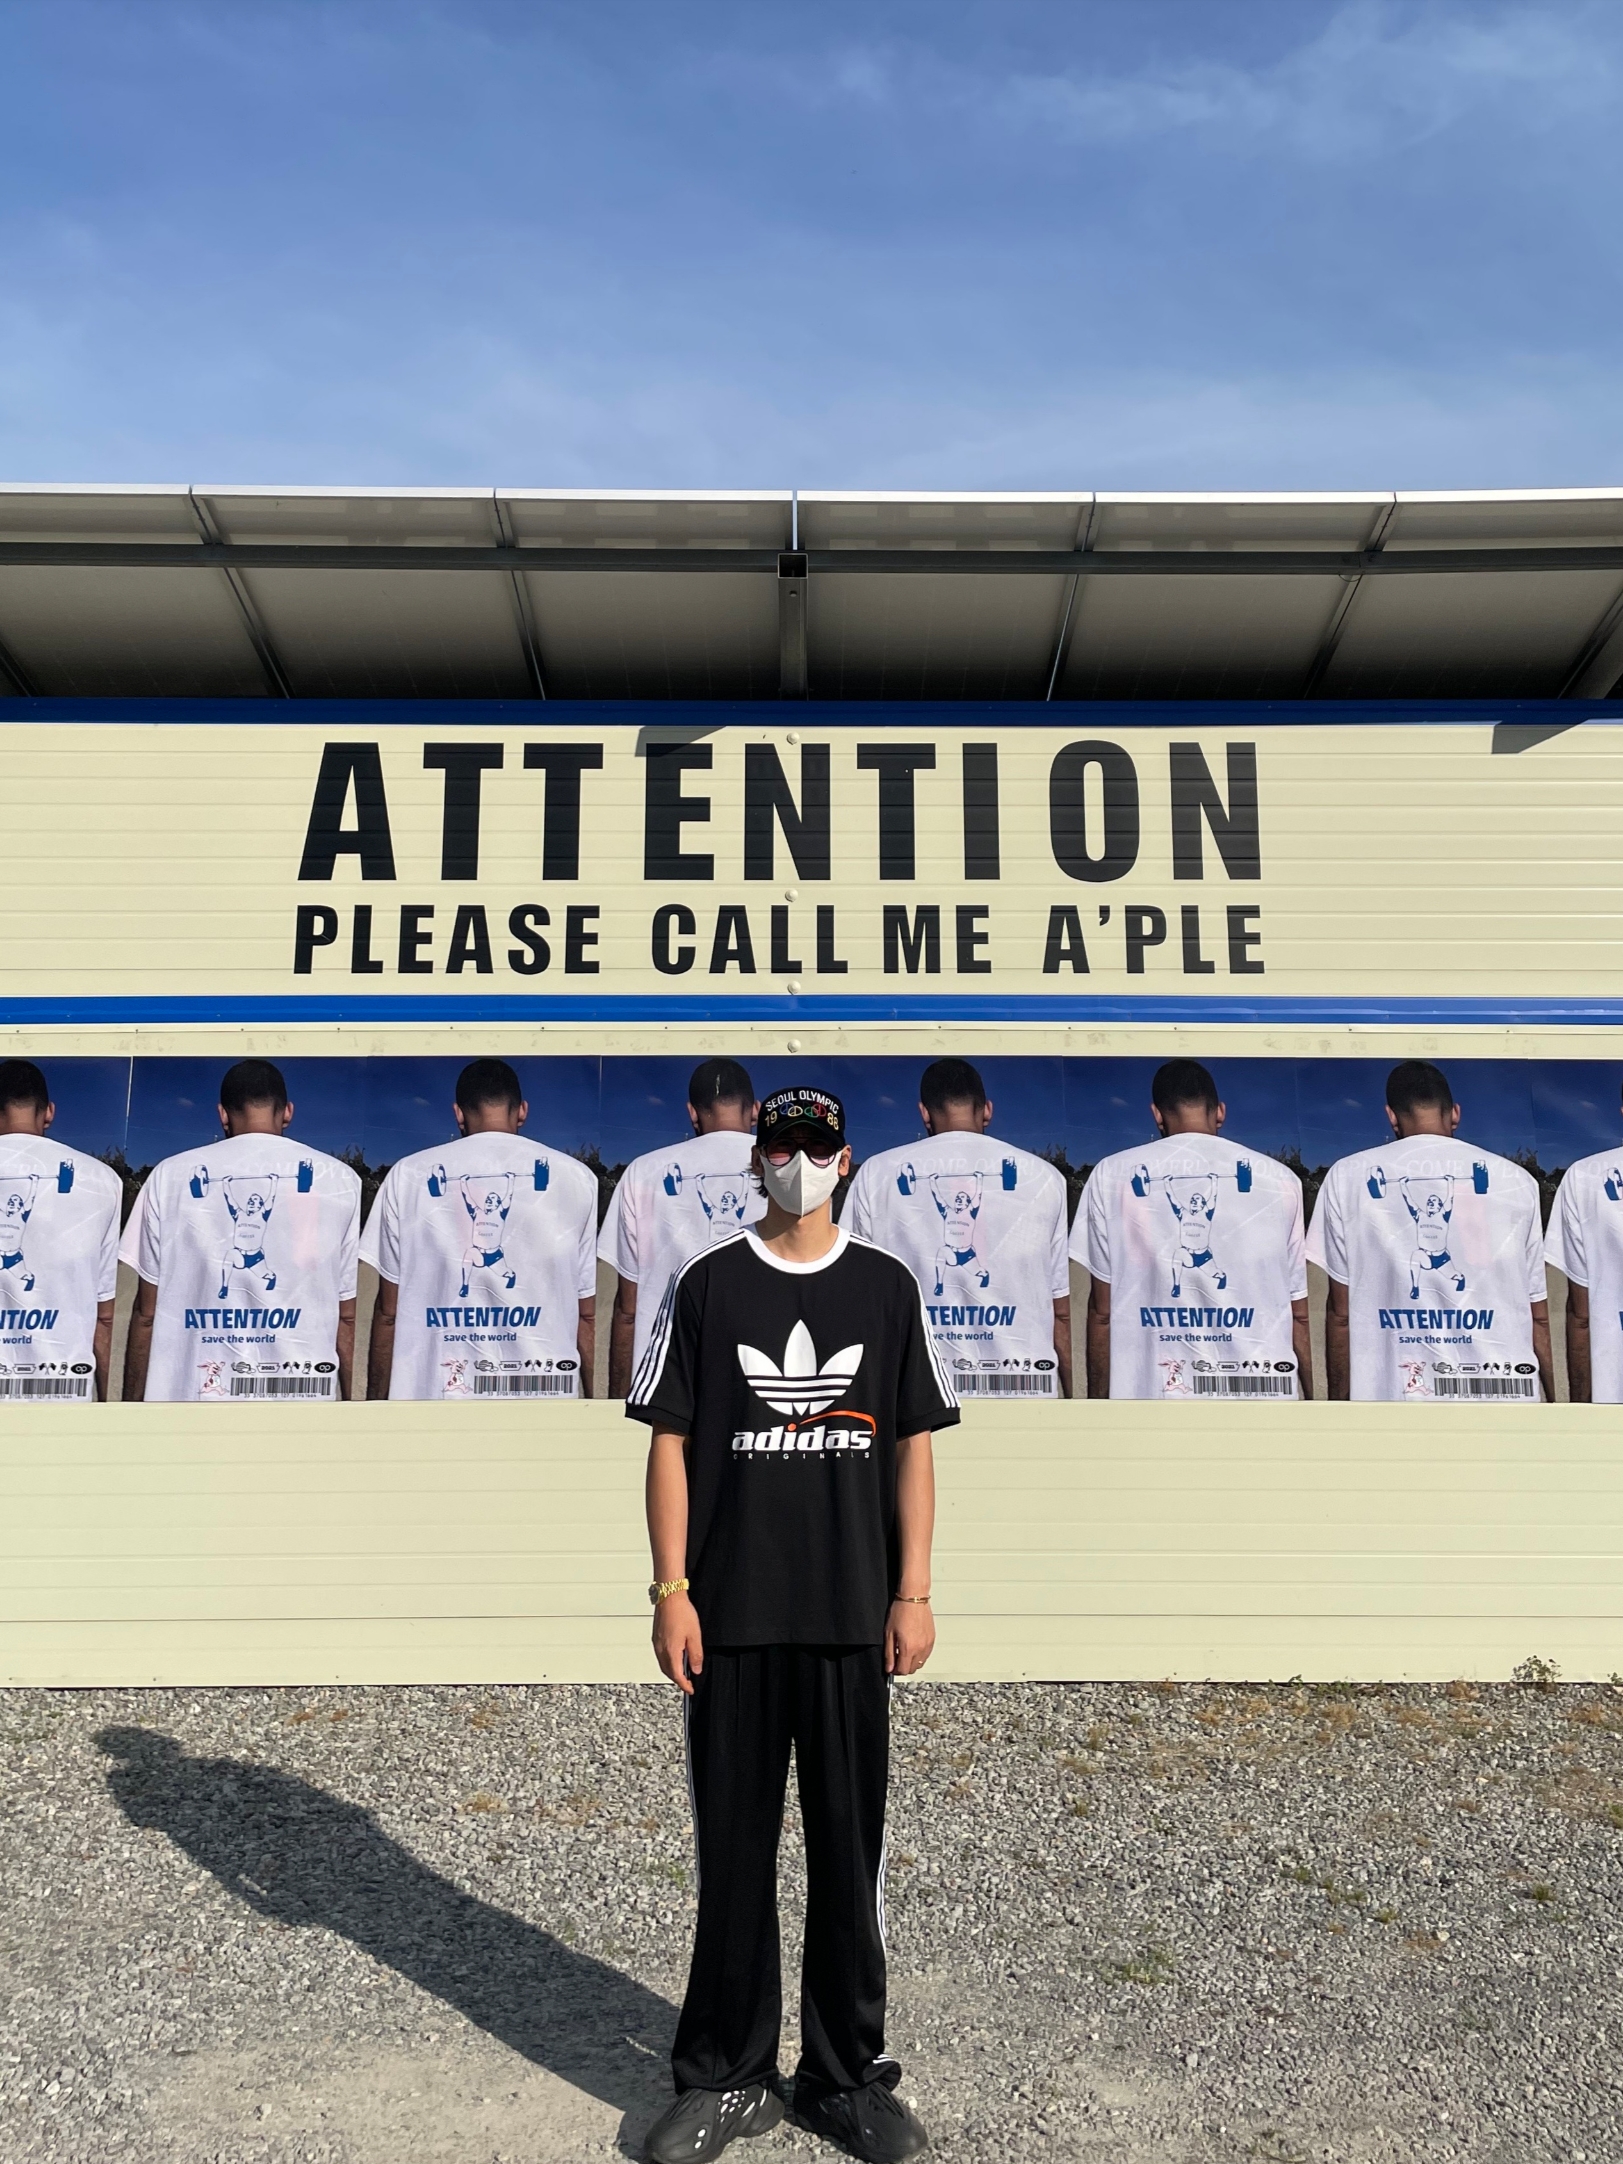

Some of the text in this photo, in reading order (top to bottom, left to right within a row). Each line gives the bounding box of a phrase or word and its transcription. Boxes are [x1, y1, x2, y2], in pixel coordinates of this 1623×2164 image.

[297, 740, 1262, 882] ATTENTION
[293, 904, 600, 975] PLEASE
[652, 904, 848, 975] CALL
[883, 904, 992, 974] ME
[765, 1089, 840, 1115] SEOUL OLYMPIC
[764, 1110, 840, 1131] 19 88
[184, 1308, 302, 1329] ATTENTION
[426, 1306, 542, 1328] ATTENTION
[1140, 1307, 1255, 1328] ATTENTION
[1378, 1309, 1494, 1330] ATTENTION
[2, 1334, 33, 1345] world
[201, 1334, 276, 1344] save the world
[443, 1332, 517, 1342] save the world
[946, 1331, 963, 1341] the
[964, 1331, 994, 1341] world
[1159, 1333, 1233, 1342] save the world
[1398, 1335, 1473, 1344] save the world
[731, 1422, 874, 1451] adidas
